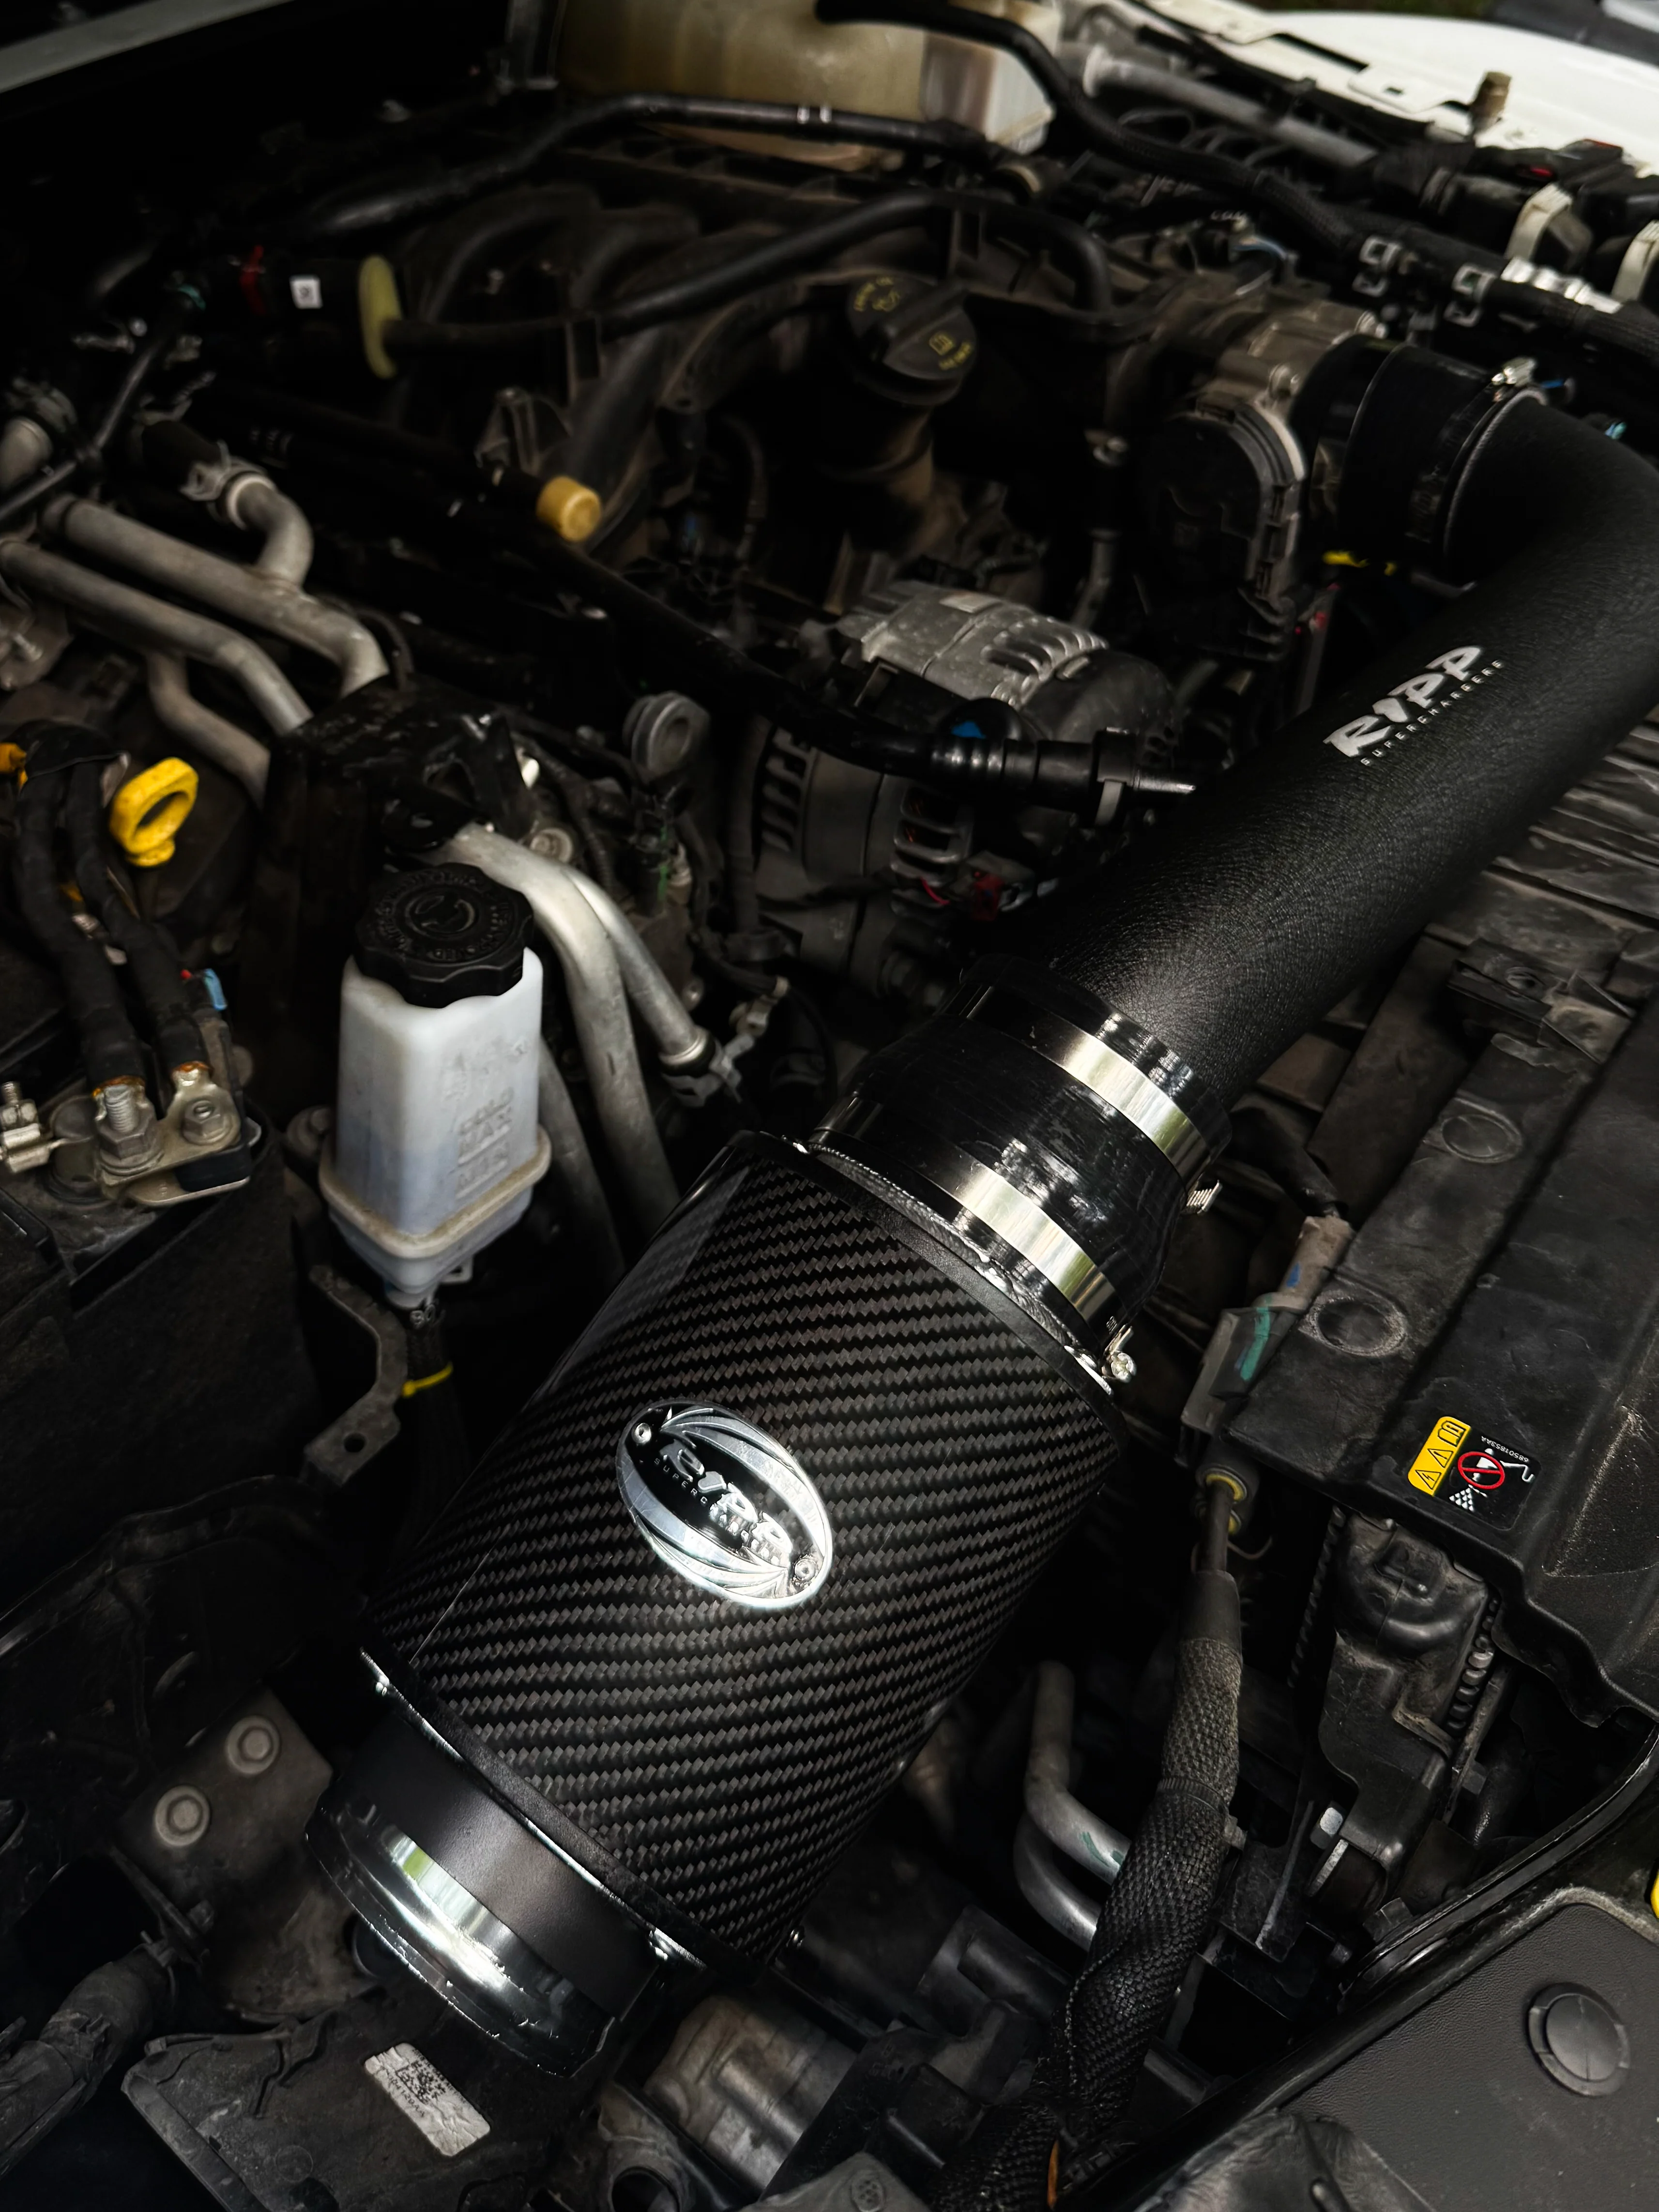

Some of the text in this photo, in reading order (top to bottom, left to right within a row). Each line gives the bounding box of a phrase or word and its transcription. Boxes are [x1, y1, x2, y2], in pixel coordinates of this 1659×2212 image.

[1323, 645, 1482, 757] RIPP
[1360, 659, 1503, 766] SUPERCHARGERS
[659, 1439, 793, 1555] RIPP
